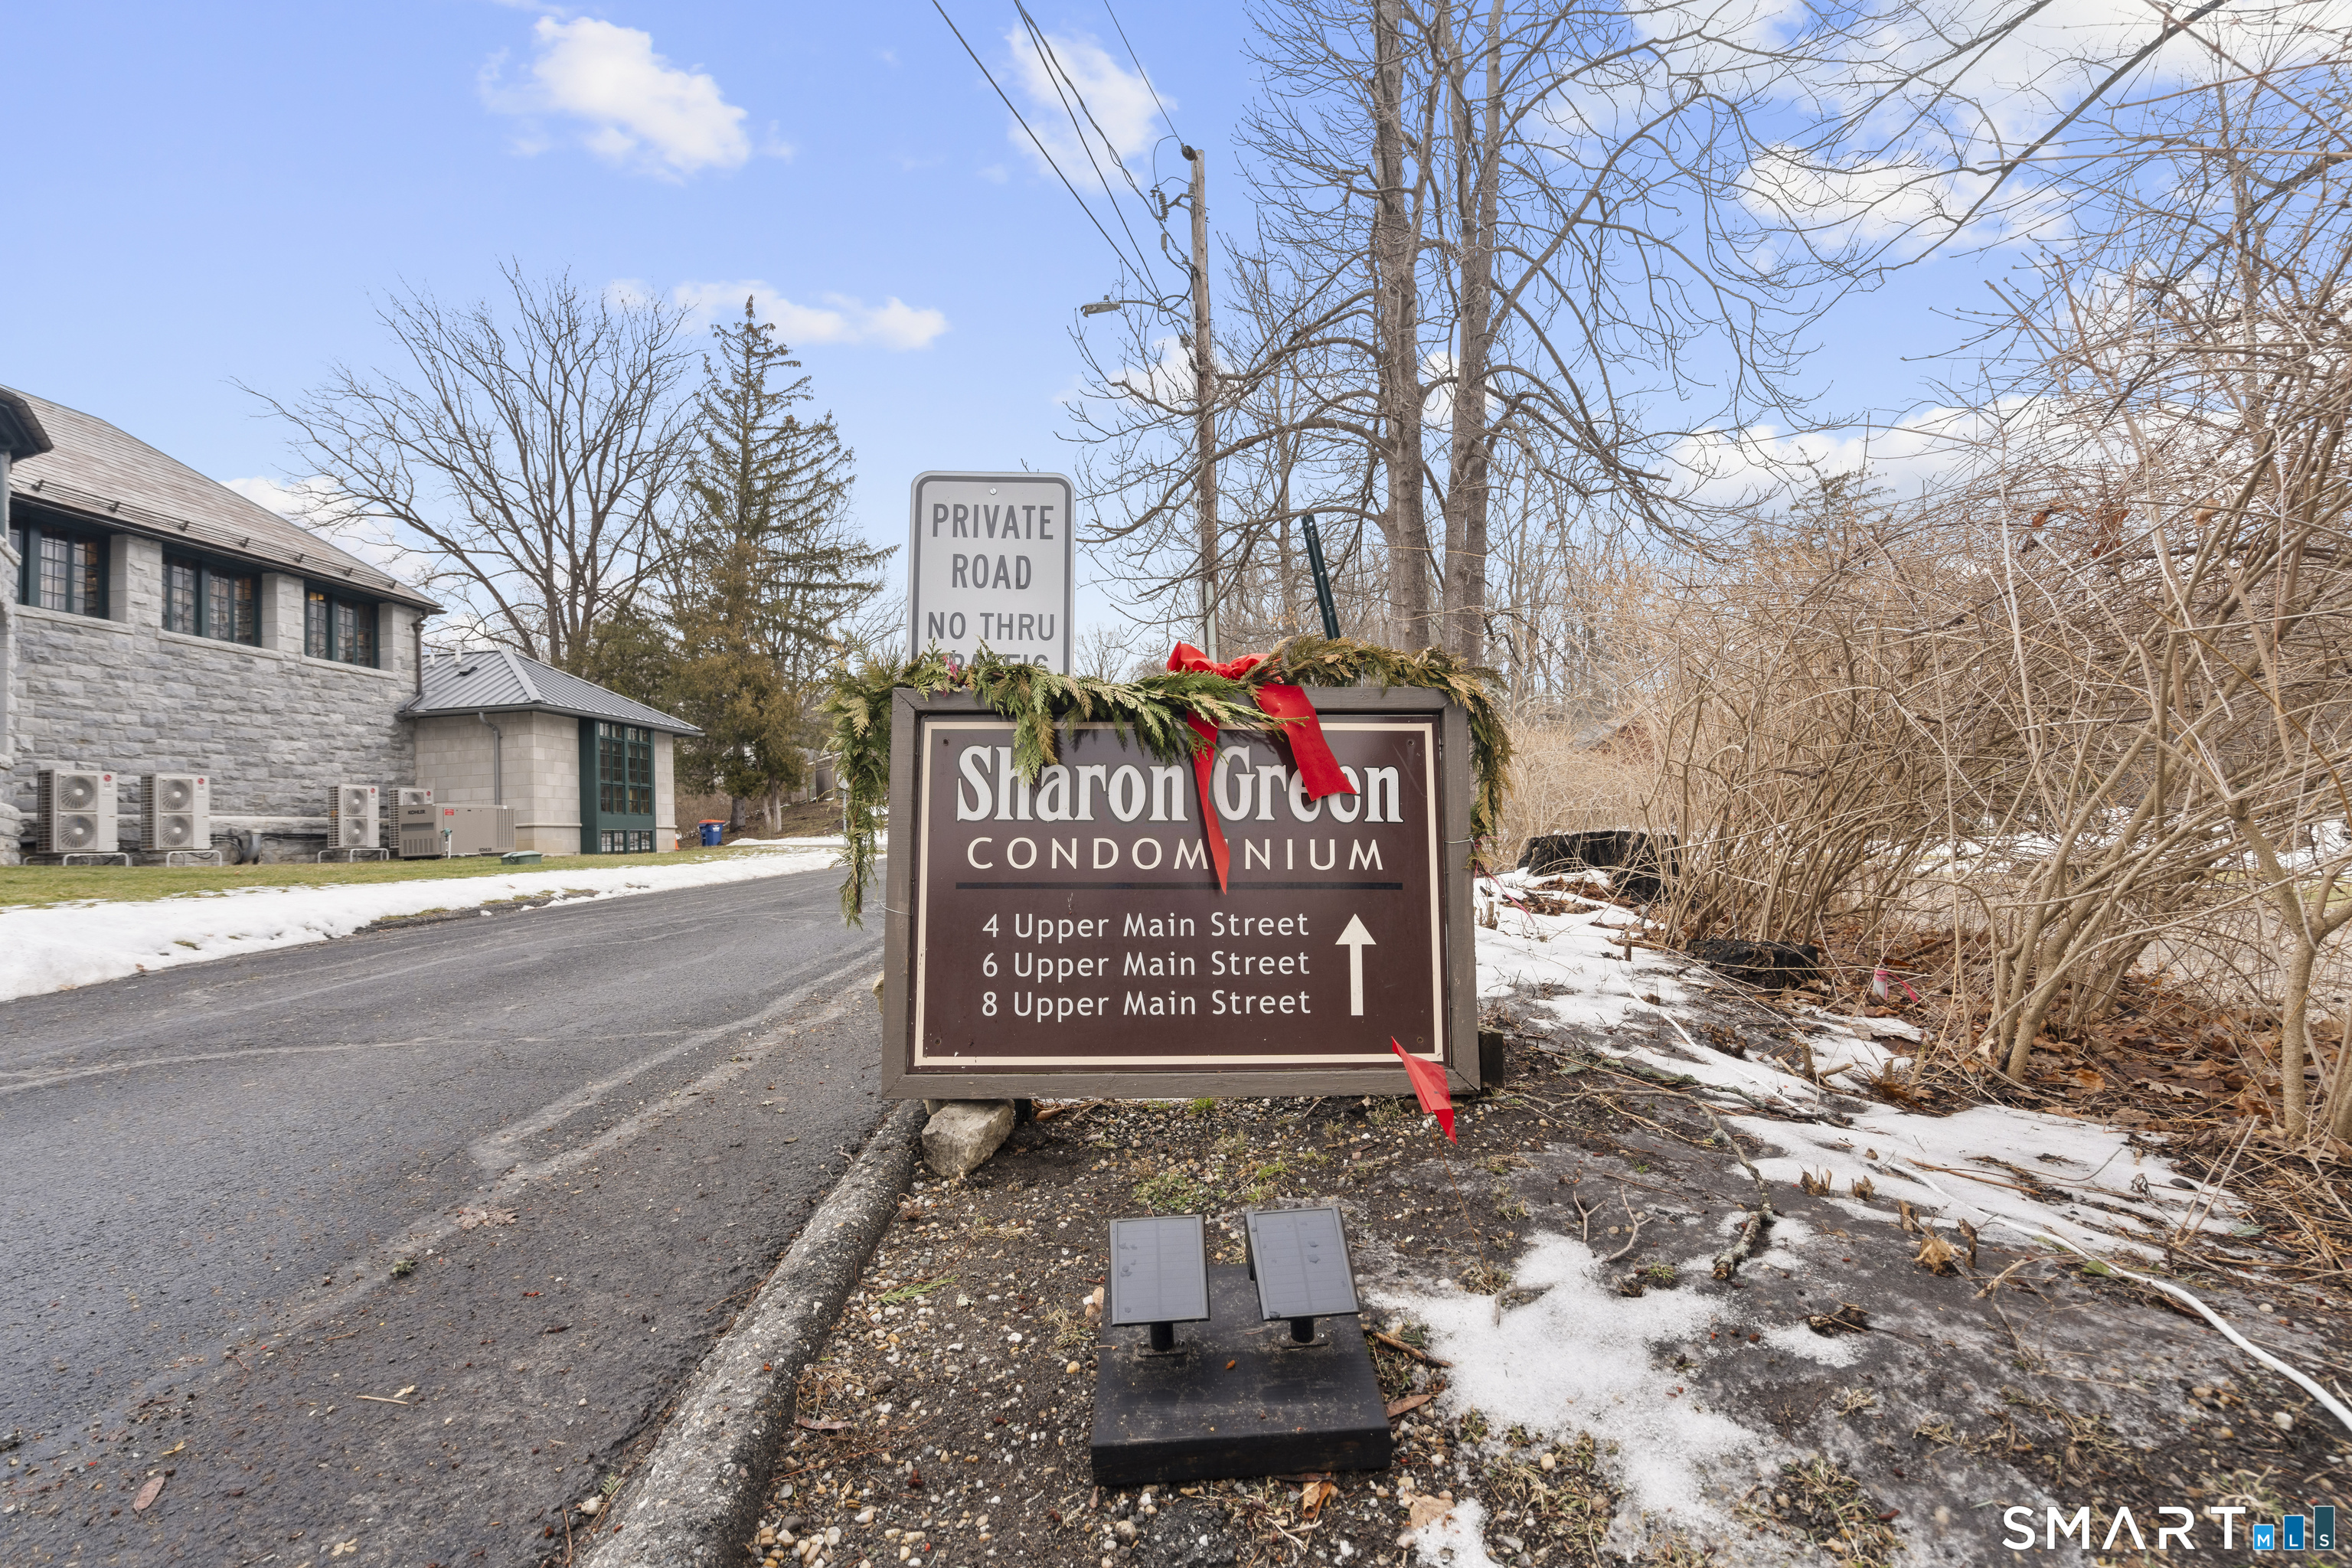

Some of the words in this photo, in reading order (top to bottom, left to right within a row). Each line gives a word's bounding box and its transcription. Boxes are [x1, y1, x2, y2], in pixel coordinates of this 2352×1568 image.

[932, 503, 1054, 540] PRIVATE
[952, 554, 1031, 590] ROAD
[928, 612, 966, 639] NO
[979, 612, 1054, 641] THRU
[957, 745, 1188, 822] Sharon
[967, 837, 1383, 871] CONDOMNIUM
[982, 913, 999, 937] 4
[1015, 913, 1109, 944] Upper
[1123, 912, 1194, 936] Main
[1210, 912, 1309, 936] Street
[982, 952, 998, 977] 6
[1014, 952, 1109, 983] Upper
[1123, 952, 1195, 976] Main
[1211, 950, 1310, 975] Street
[982, 991, 998, 1016] 8
[1014, 991, 1109, 1023] Upper
[1123, 990, 1196, 1015] Main
[1212, 990, 1311, 1014] Street
